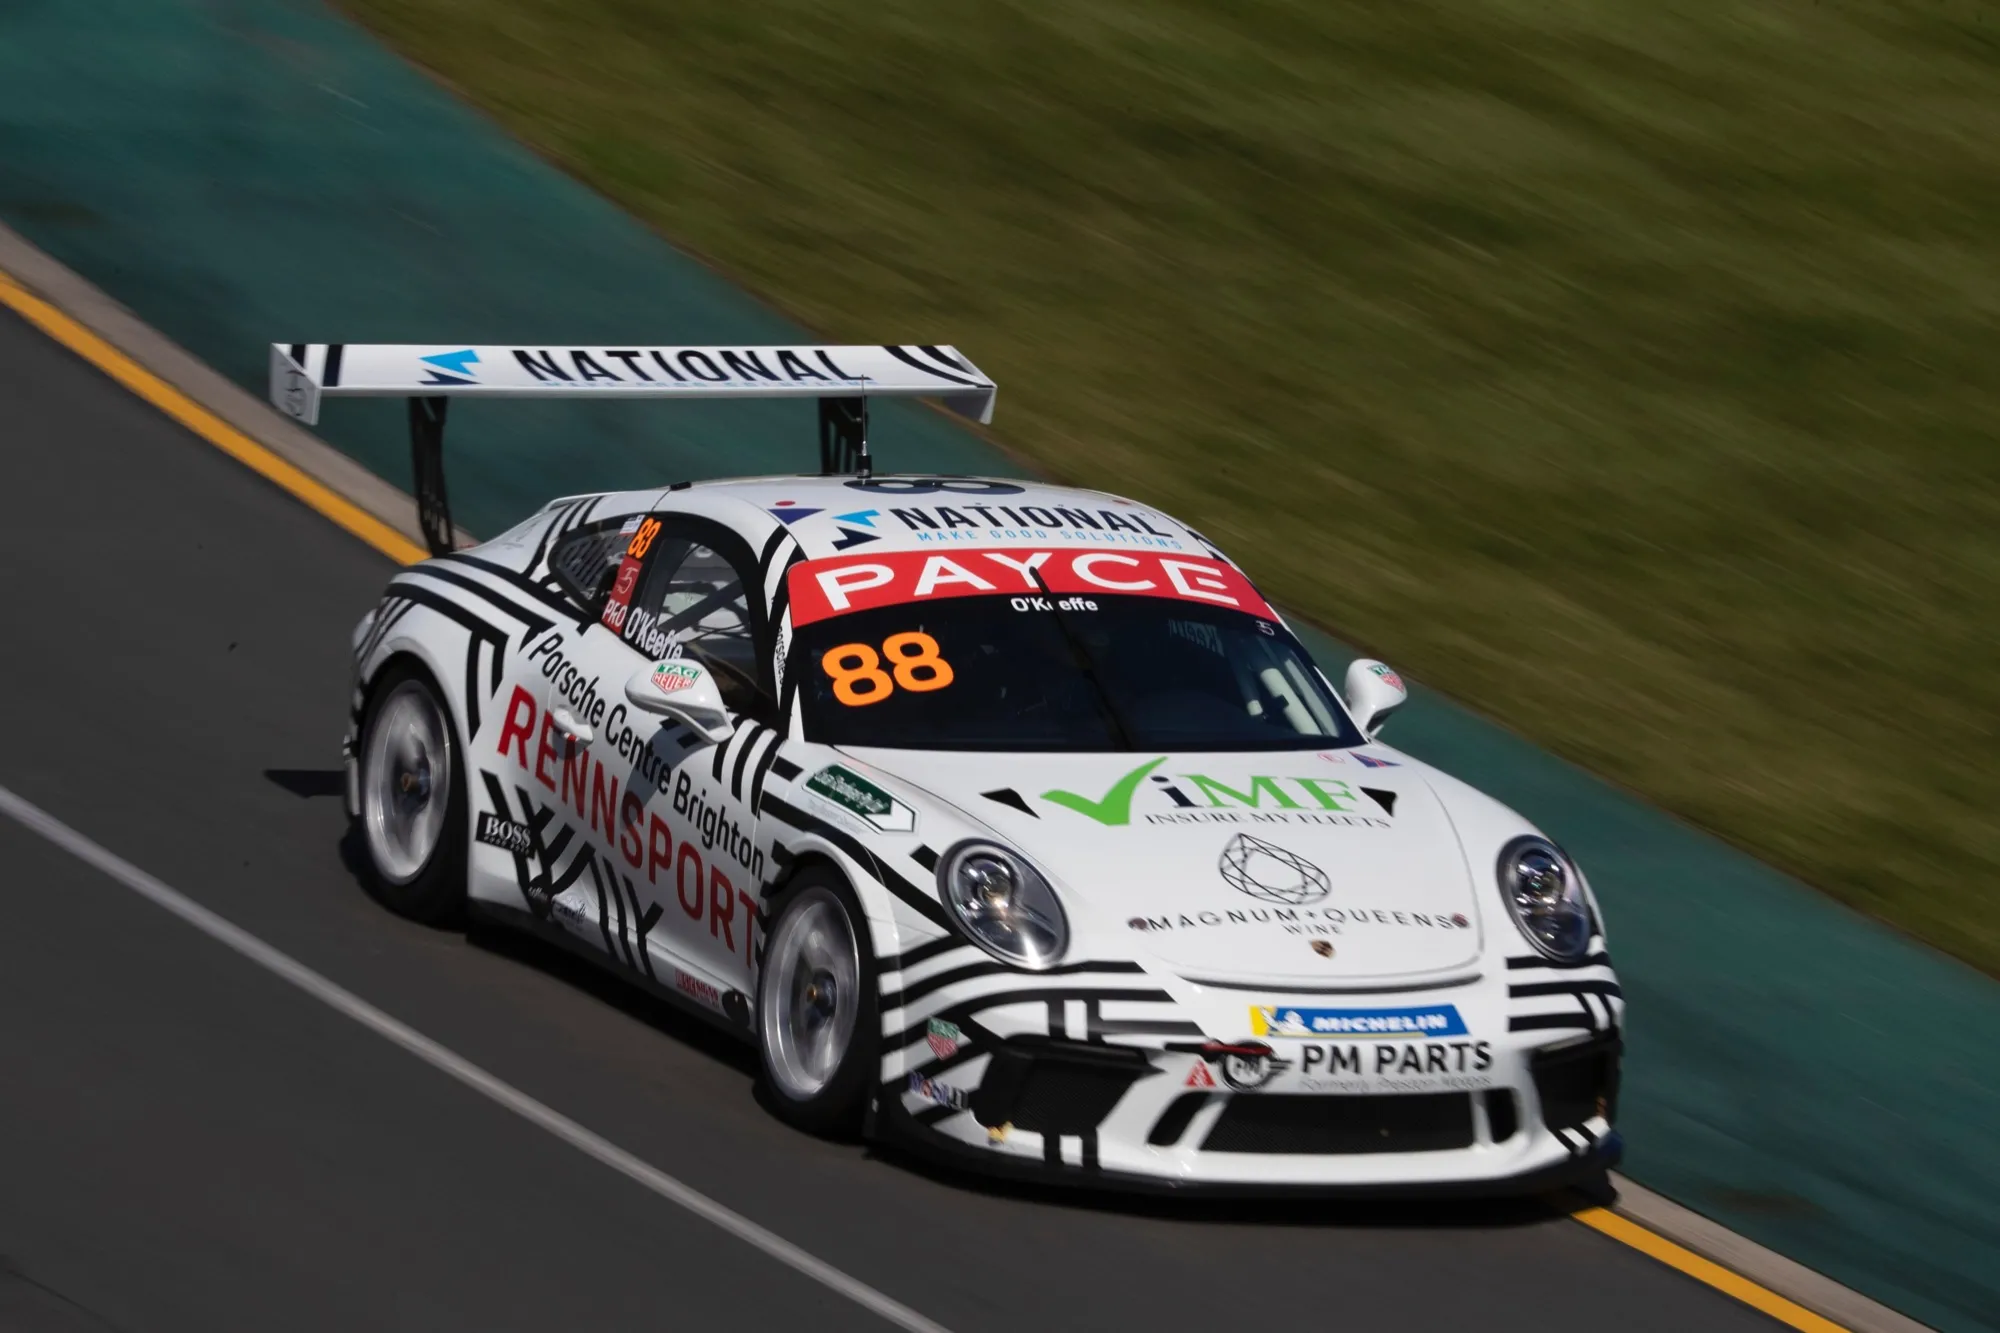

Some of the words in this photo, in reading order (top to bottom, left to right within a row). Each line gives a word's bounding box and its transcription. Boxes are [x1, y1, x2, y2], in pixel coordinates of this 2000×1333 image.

[512, 350, 872, 382] NATIONAL
[888, 505, 1174, 538] NATIONAL
[917, 530, 977, 542] MAKE
[992, 530, 1048, 539] GOOD
[1062, 530, 1183, 550] SOLUTIONS
[815, 552, 1240, 612] PAYCE
[661, 664, 698, 679] TAG
[822, 631, 954, 706] 88
[528, 632, 606, 728] Porsche
[605, 703, 672, 795] Centre
[673, 769, 764, 882] Brighton
[484, 816, 532, 848] BOSS
[497, 684, 759, 970] RENNSPORT
[1145, 812, 1246, 826] INSURE
[1250, 813, 1292, 825] MY
[1282, 923, 1343, 936] WINE
[1312, 1014, 1448, 1032] MICHELIN
[1301, 1044, 1362, 1075] PM
[1373, 1040, 1494, 1075] PARTS
